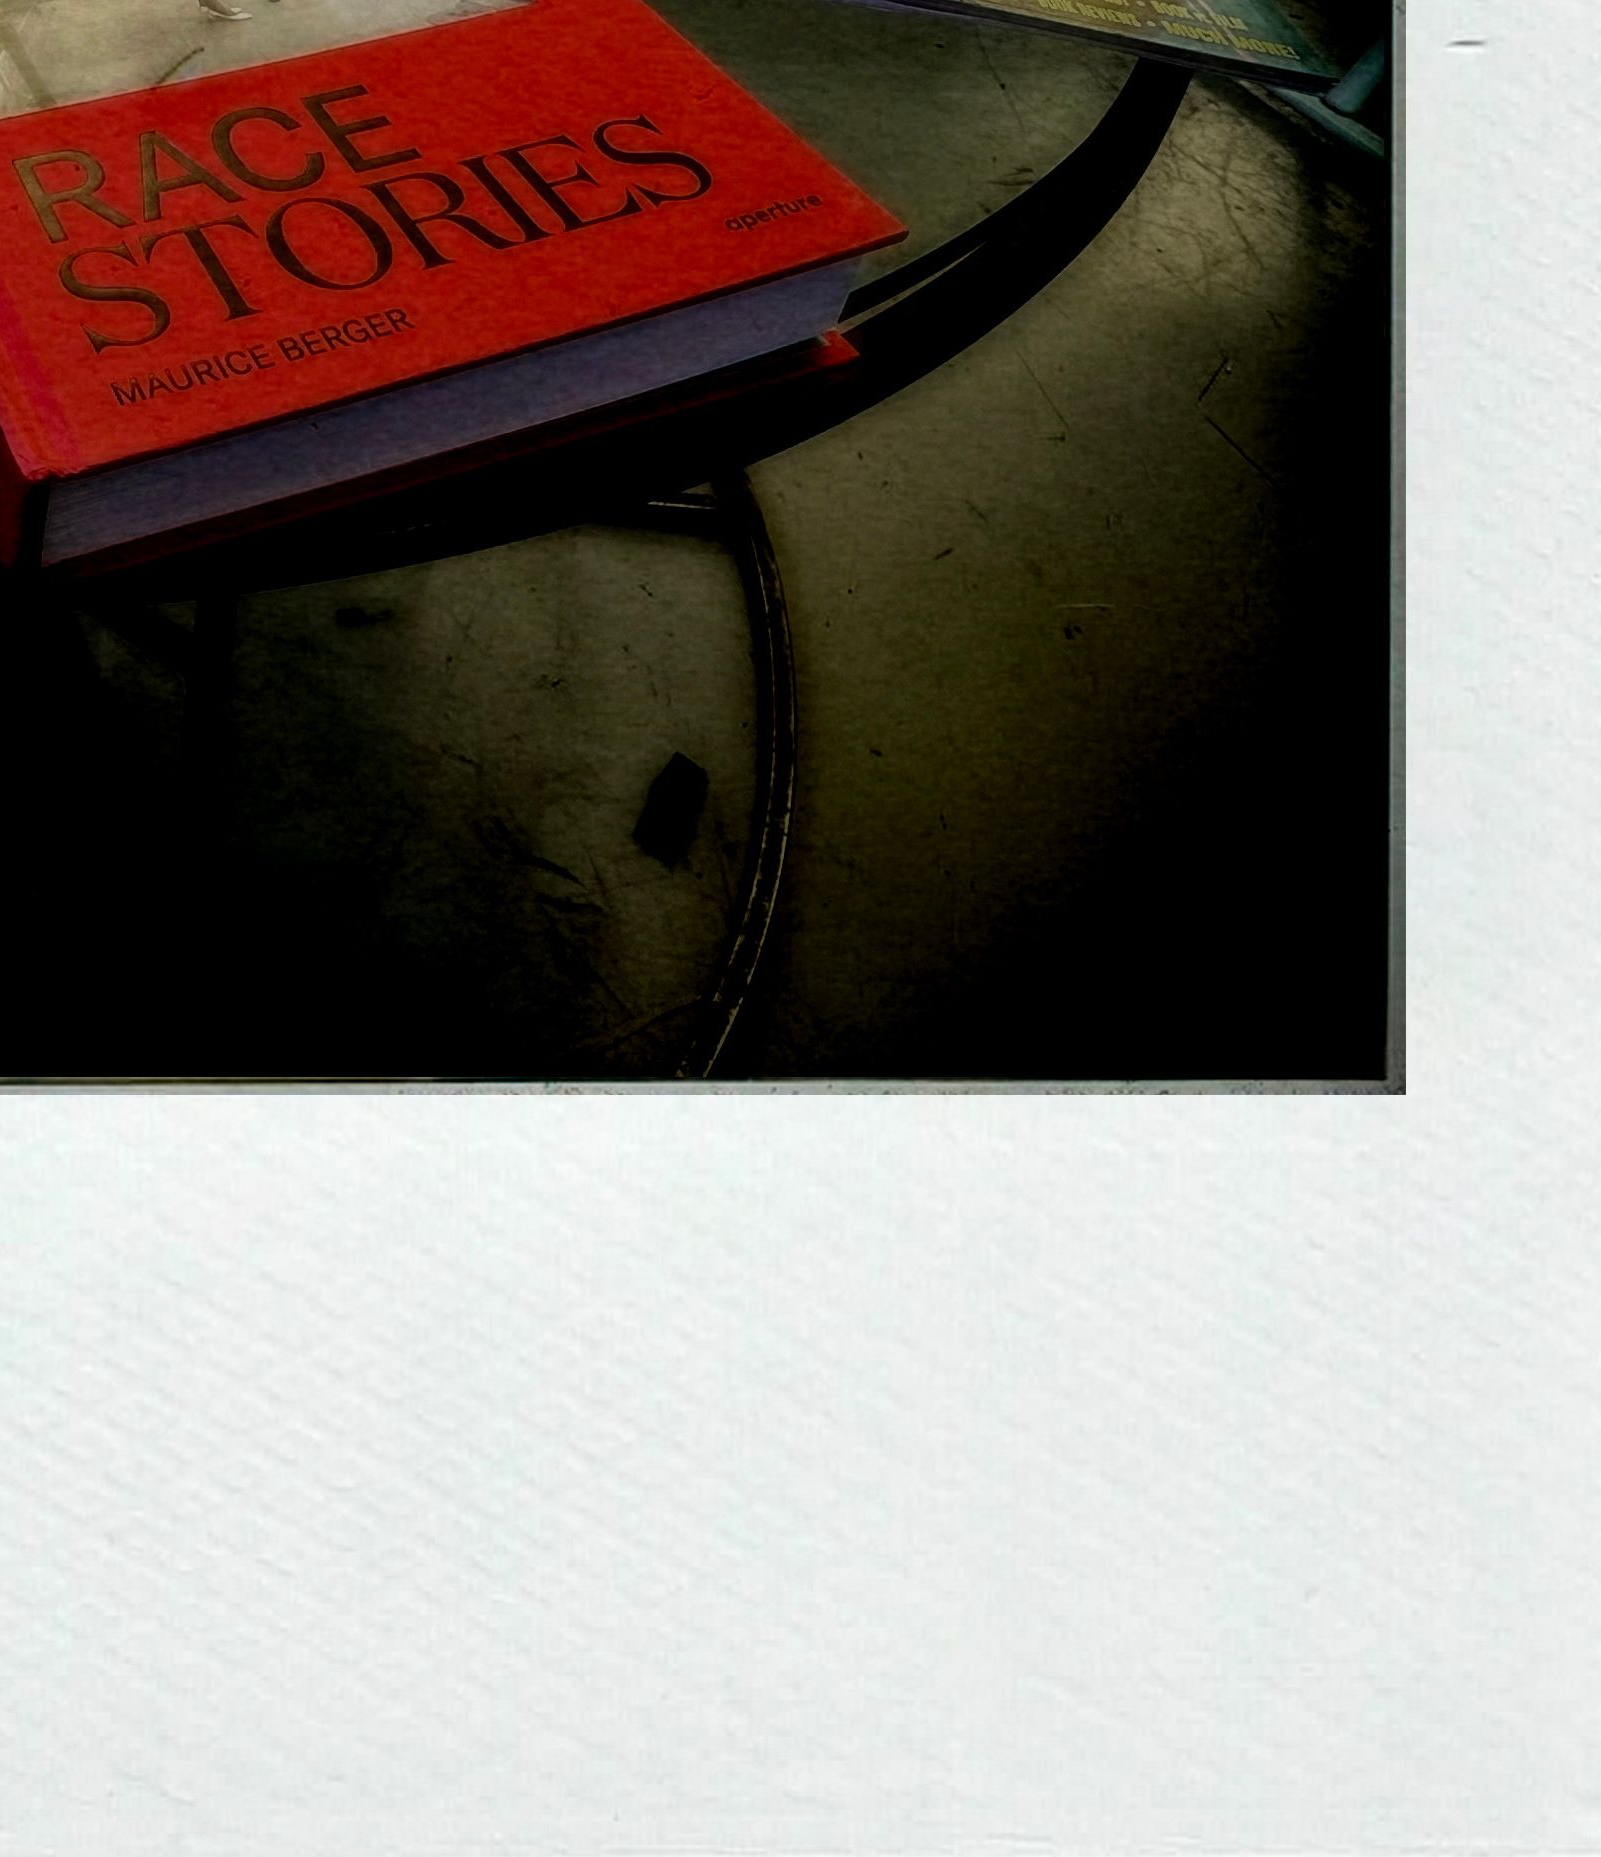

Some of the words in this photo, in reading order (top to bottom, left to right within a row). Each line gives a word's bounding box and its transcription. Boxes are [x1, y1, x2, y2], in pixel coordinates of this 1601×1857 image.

[1076, 3, 1142, 28] REVIEWS
[1160, 20, 1229, 45] MUCH
[1229, 36, 1300, 60] MORE!
[1150, 0, 1194, 20] BOOK
[12, 84, 422, 244] RACE
[57, 113, 714, 355] STORIES
[724, 194, 824, 231] aperture
[110, 343, 276, 406] MAURICE
[276, 308, 416, 363] BERGER
